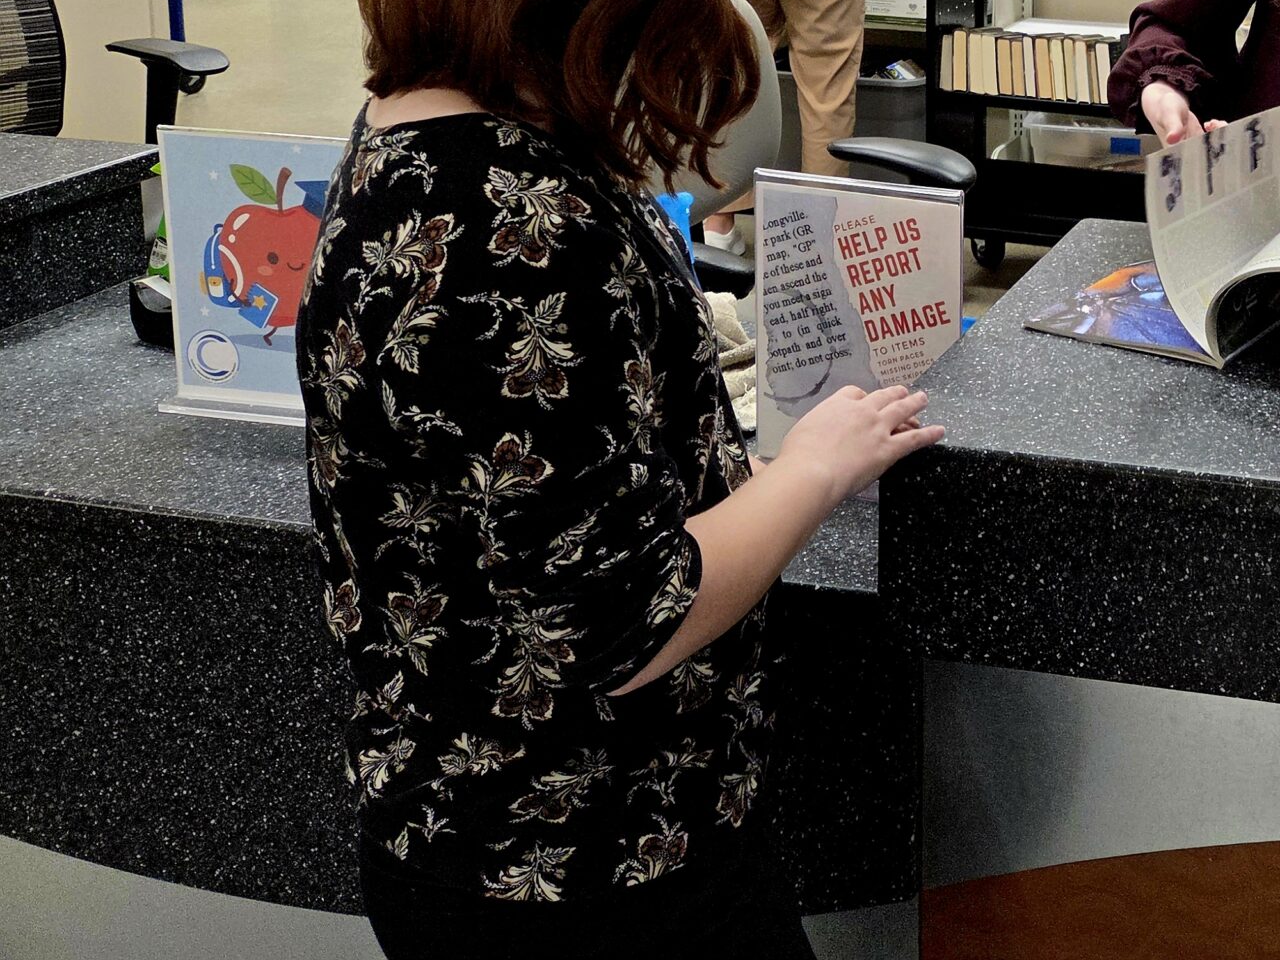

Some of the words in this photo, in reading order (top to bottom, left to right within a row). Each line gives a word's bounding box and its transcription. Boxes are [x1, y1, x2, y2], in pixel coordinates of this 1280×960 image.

[834, 214, 876, 234] PLEASE
[770, 232, 791, 247] park
[793, 224, 814, 240] (GR
[837, 226, 888, 260] HELP
[892, 218, 922, 244] US
[770, 265, 780, 276] of
[780, 262, 804, 275] these
[806, 254, 823, 268] and
[846, 247, 922, 288] REPORT
[780, 275, 811, 292] ascend
[812, 272, 828, 284] the
[764, 301, 780, 314] you
[782, 294, 804, 307] meet
[812, 288, 832, 300] sign
[858, 284, 896, 315] ANY
[790, 307, 810, 321] half
[811, 302, 838, 316] right,
[864, 300, 952, 342] DAMAGE
[782, 330, 792, 340] to
[797, 325, 811, 337] (in
[816, 316, 842, 332] quick
[805, 337, 822, 350] and
[826, 332, 847, 344] over
[872, 346, 888, 357] TO
[892, 337, 926, 352] ITEMS
[794, 355, 807, 368] do
[809, 352, 823, 364] not
[878, 358, 898, 368] TORN
[900, 350, 924, 361] PAGES
[880, 364, 912, 376] MISSING
[883, 376, 900, 385] DISC
